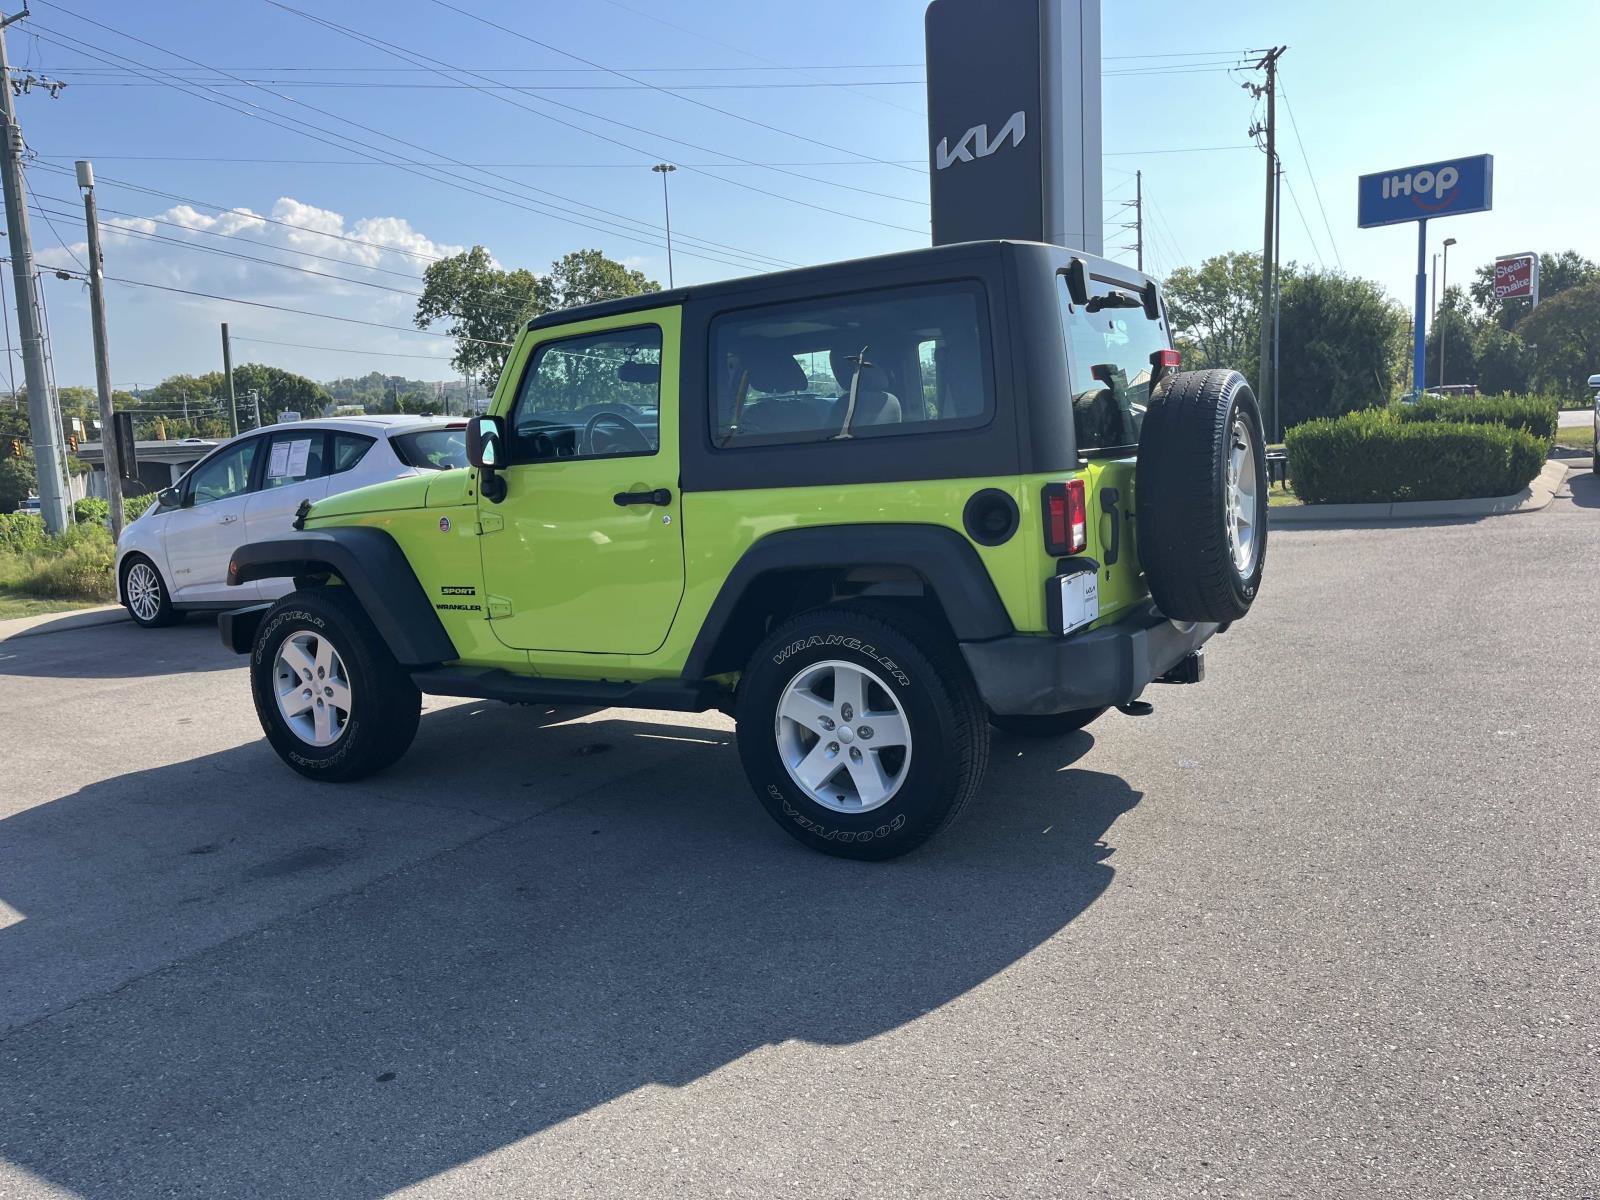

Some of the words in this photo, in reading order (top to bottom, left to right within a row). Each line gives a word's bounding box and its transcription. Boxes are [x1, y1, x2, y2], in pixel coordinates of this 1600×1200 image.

[936, 111, 1026, 170] KIA
[1382, 166, 1459, 200] IHOP
[1496, 259, 1528, 278] Steak
[1495, 278, 1530, 298] Shake
[436, 603, 482, 612] WRANGLER
[442, 587, 474, 595] SPORT
[255, 610, 326, 665] GOODYEAR
[773, 634, 910, 687] WRANGLER
[767, 784, 906, 843] GOODYEAR
